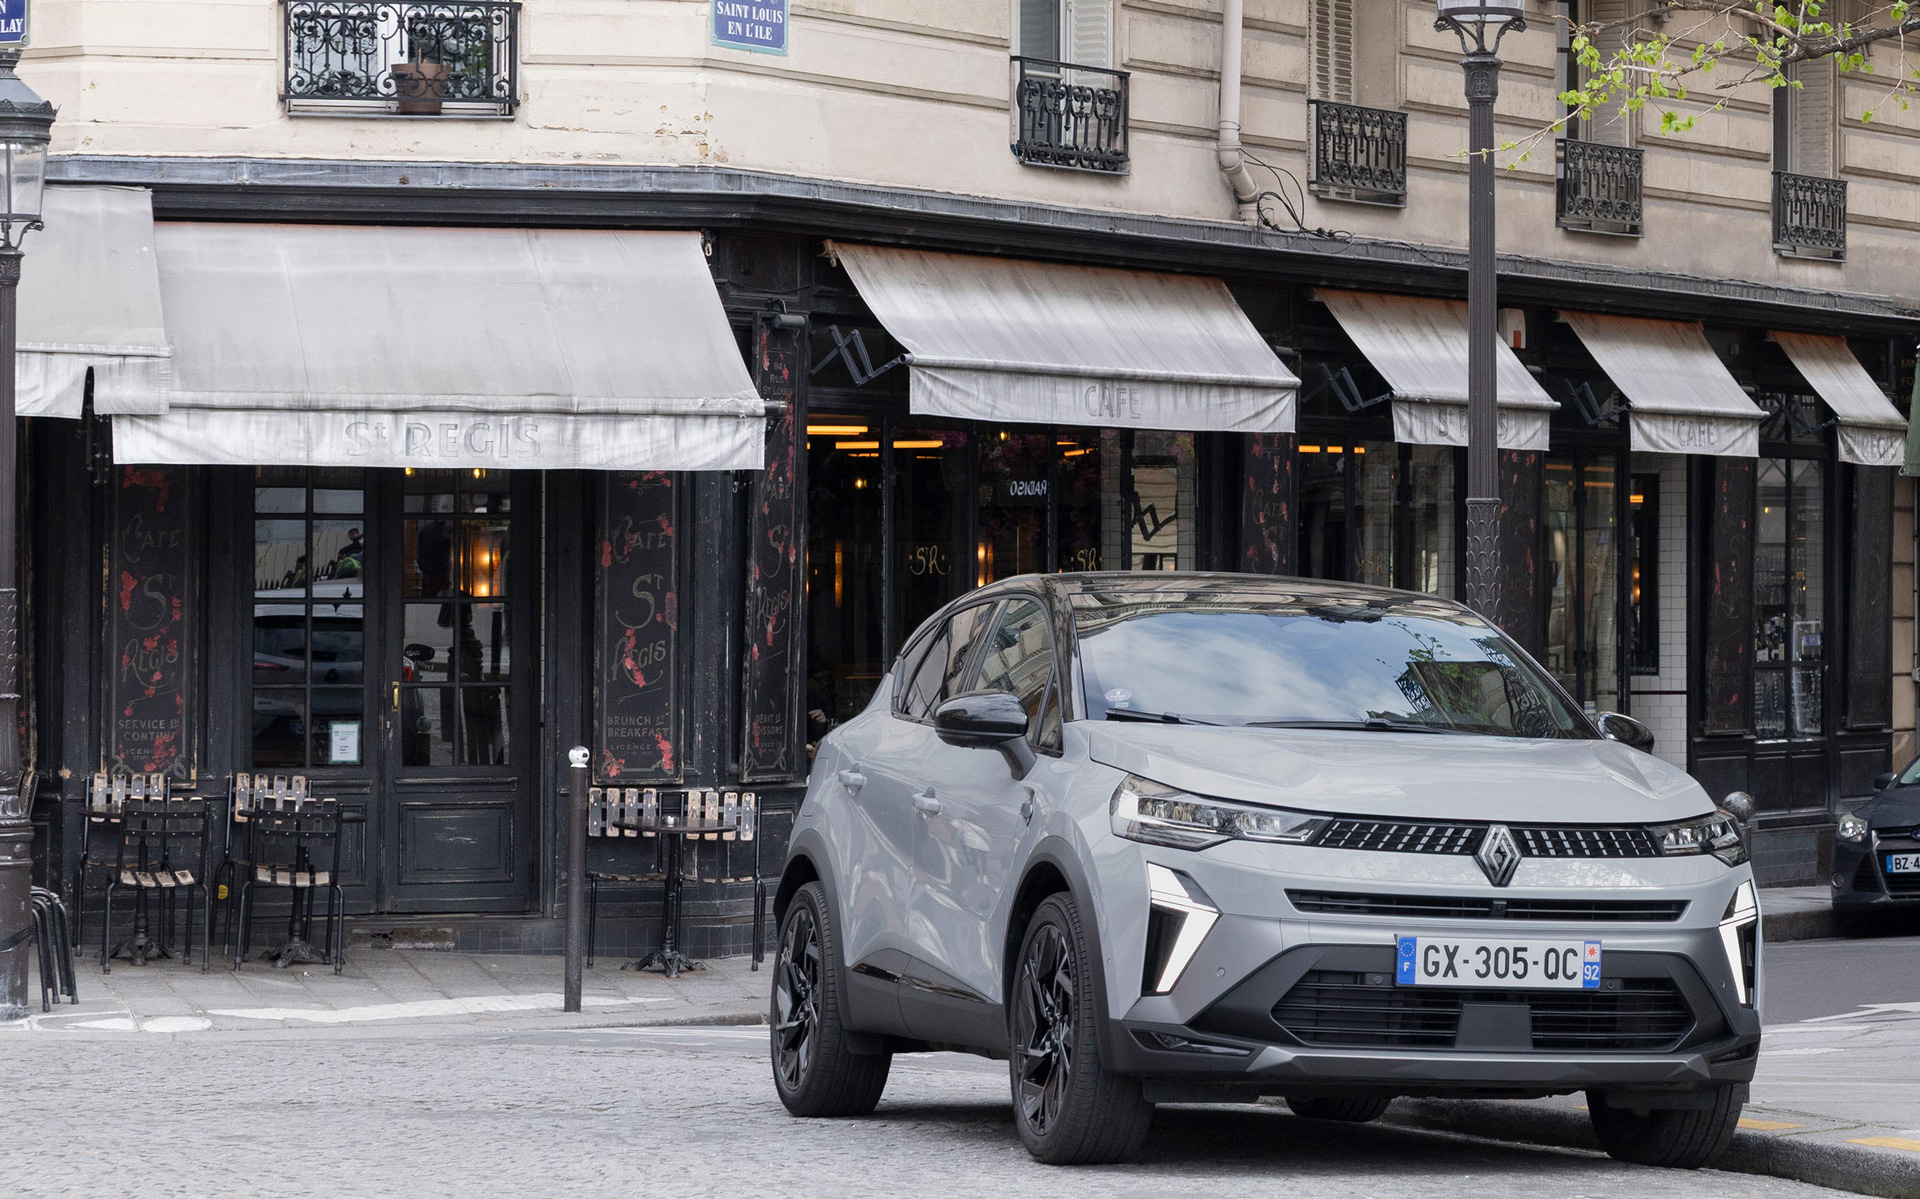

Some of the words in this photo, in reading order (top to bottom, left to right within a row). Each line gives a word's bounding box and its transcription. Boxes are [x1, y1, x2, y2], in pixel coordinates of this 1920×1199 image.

[717, 1, 749, 19] SAINT
[752, 6, 783, 24] LOUIS
[728, 21, 742, 36] EN
[1084, 385, 1141, 419] CAFE
[405, 422, 542, 458] REGIS
[119, 720, 165, 729] SERVICE
[607, 716, 651, 725] BRUNCH
[607, 728, 669, 737] BREAKFAST
[1403, 961, 1410, 972] F
[1423, 944, 1578, 980] GX-305-QC
[1584, 965, 1599, 981] 92
